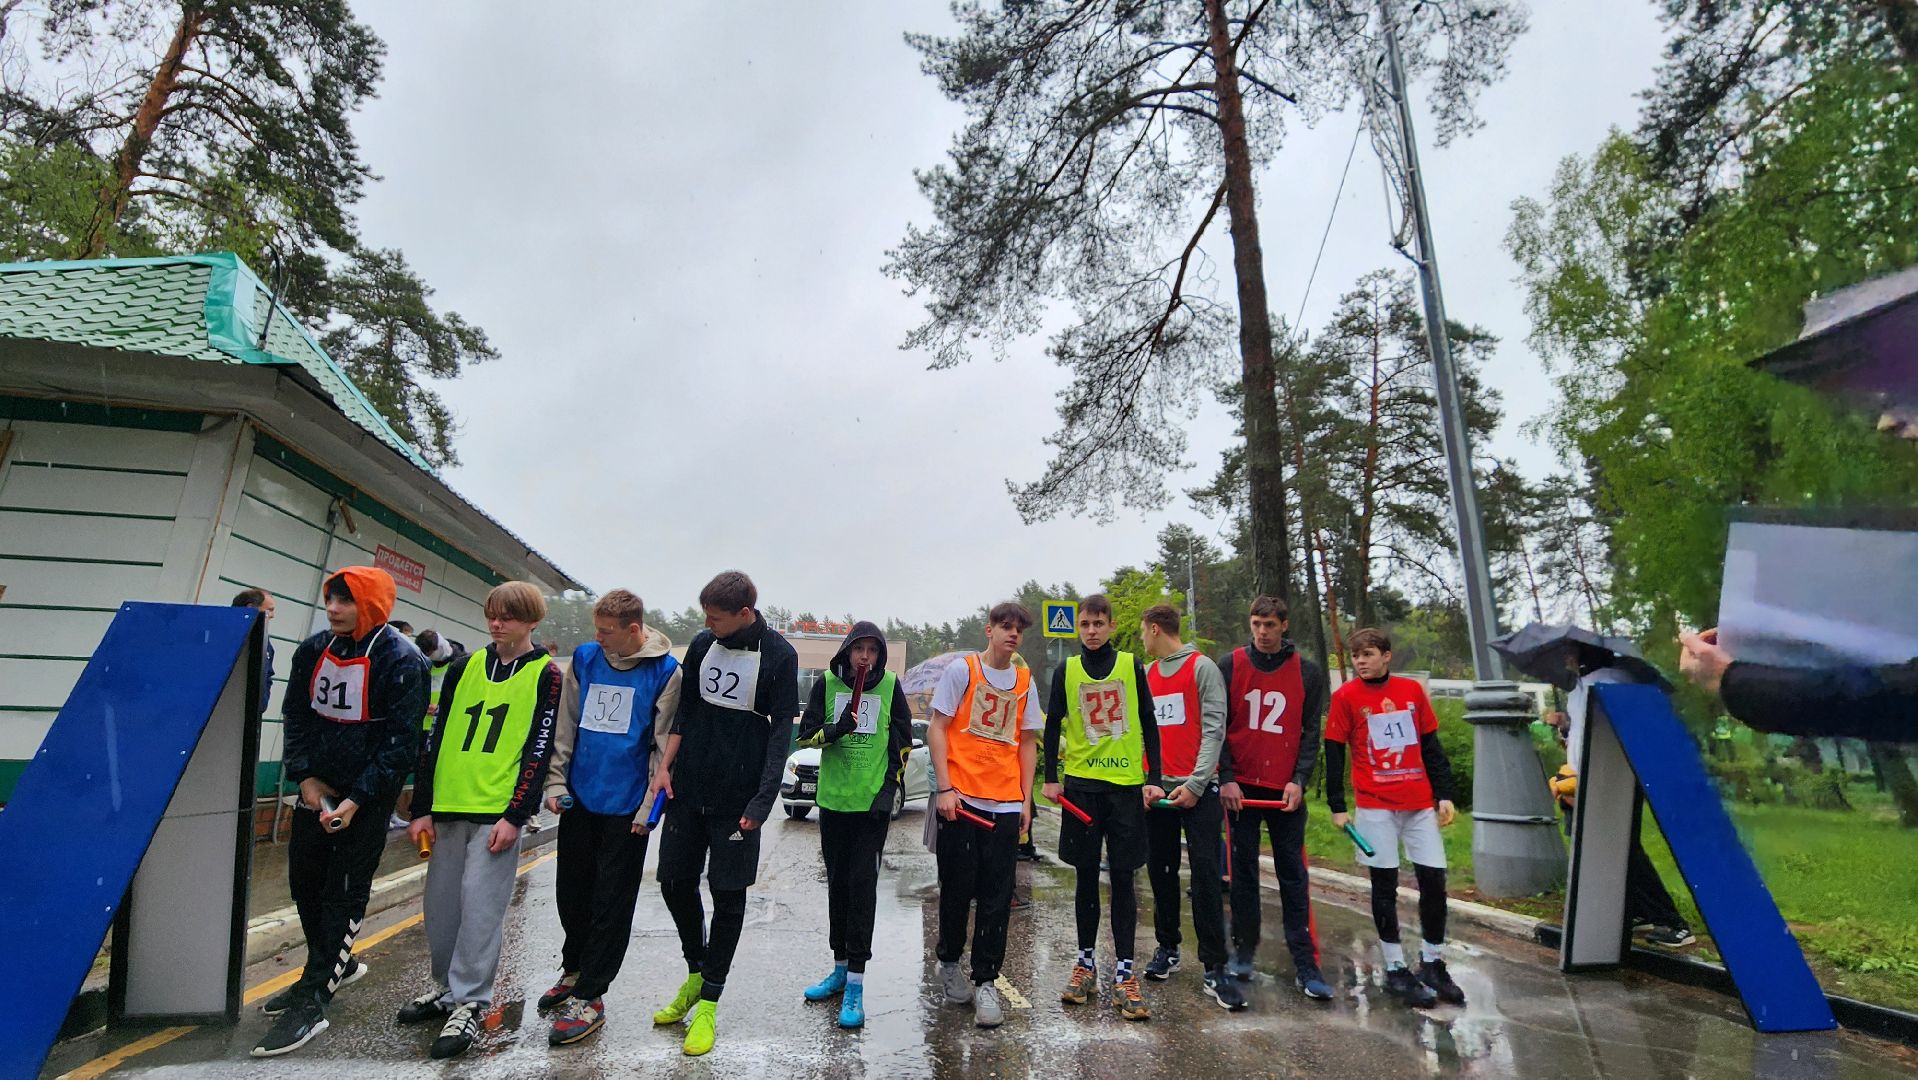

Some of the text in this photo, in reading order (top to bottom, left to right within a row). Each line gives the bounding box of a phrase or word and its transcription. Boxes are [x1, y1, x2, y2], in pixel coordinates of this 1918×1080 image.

[316, 676, 352, 709] 31
[705, 667, 740, 700] 32
[594, 690, 622, 721] 52
[981, 692, 1011, 729] 21
[1086, 689, 1122, 725] 22
[1156, 703, 1174, 720] 42
[1244, 688, 1286, 734] 12
[461, 700, 510, 753] 11
[511, 663, 561, 809] OMMY TOMMY TOMMY
[1384, 721, 1405, 739] 41
[1086, 757, 1129, 768] VIKING
